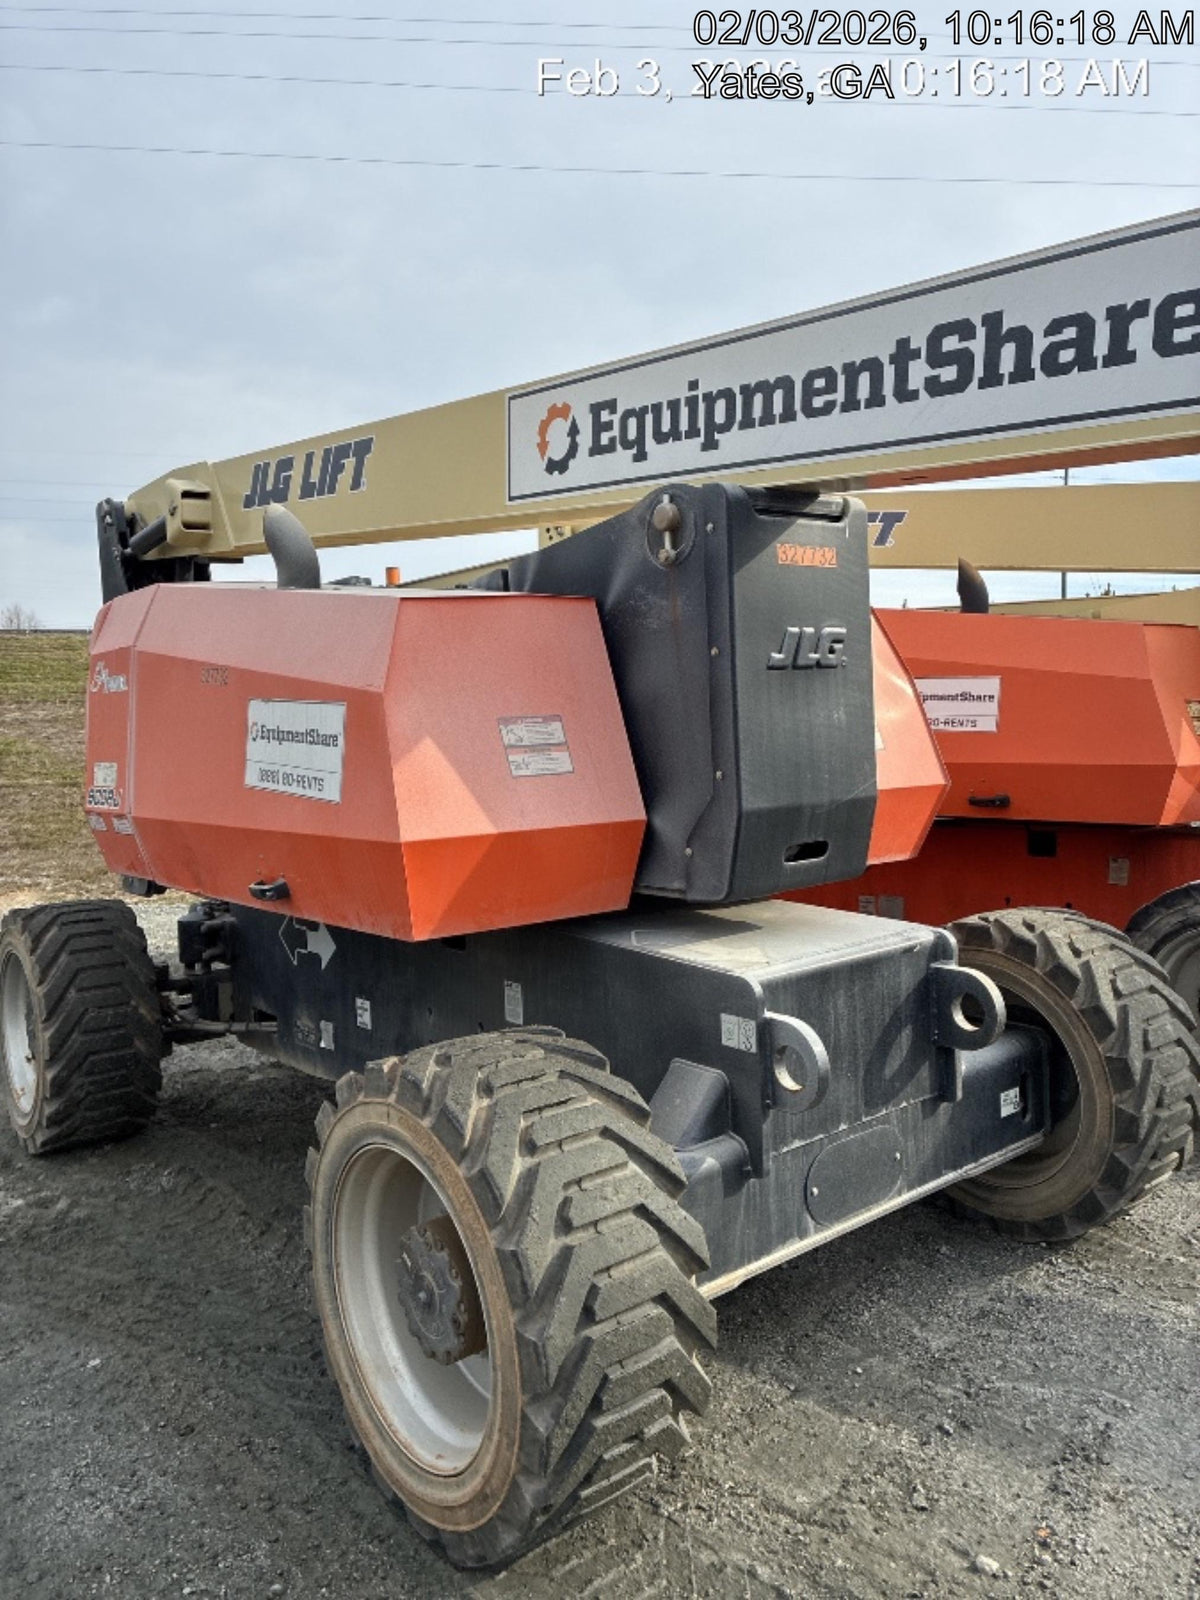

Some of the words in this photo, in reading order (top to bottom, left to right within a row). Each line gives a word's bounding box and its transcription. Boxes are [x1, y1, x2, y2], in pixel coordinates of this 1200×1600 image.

[588, 287, 1200, 464] EquipmentShare
[242, 455, 295, 511] JLG
[298, 435, 376, 501] LIFT
[778, 545, 838, 567] 327732
[766, 626, 847, 670] JLG
[260, 724, 339, 748] EquipmentShare
